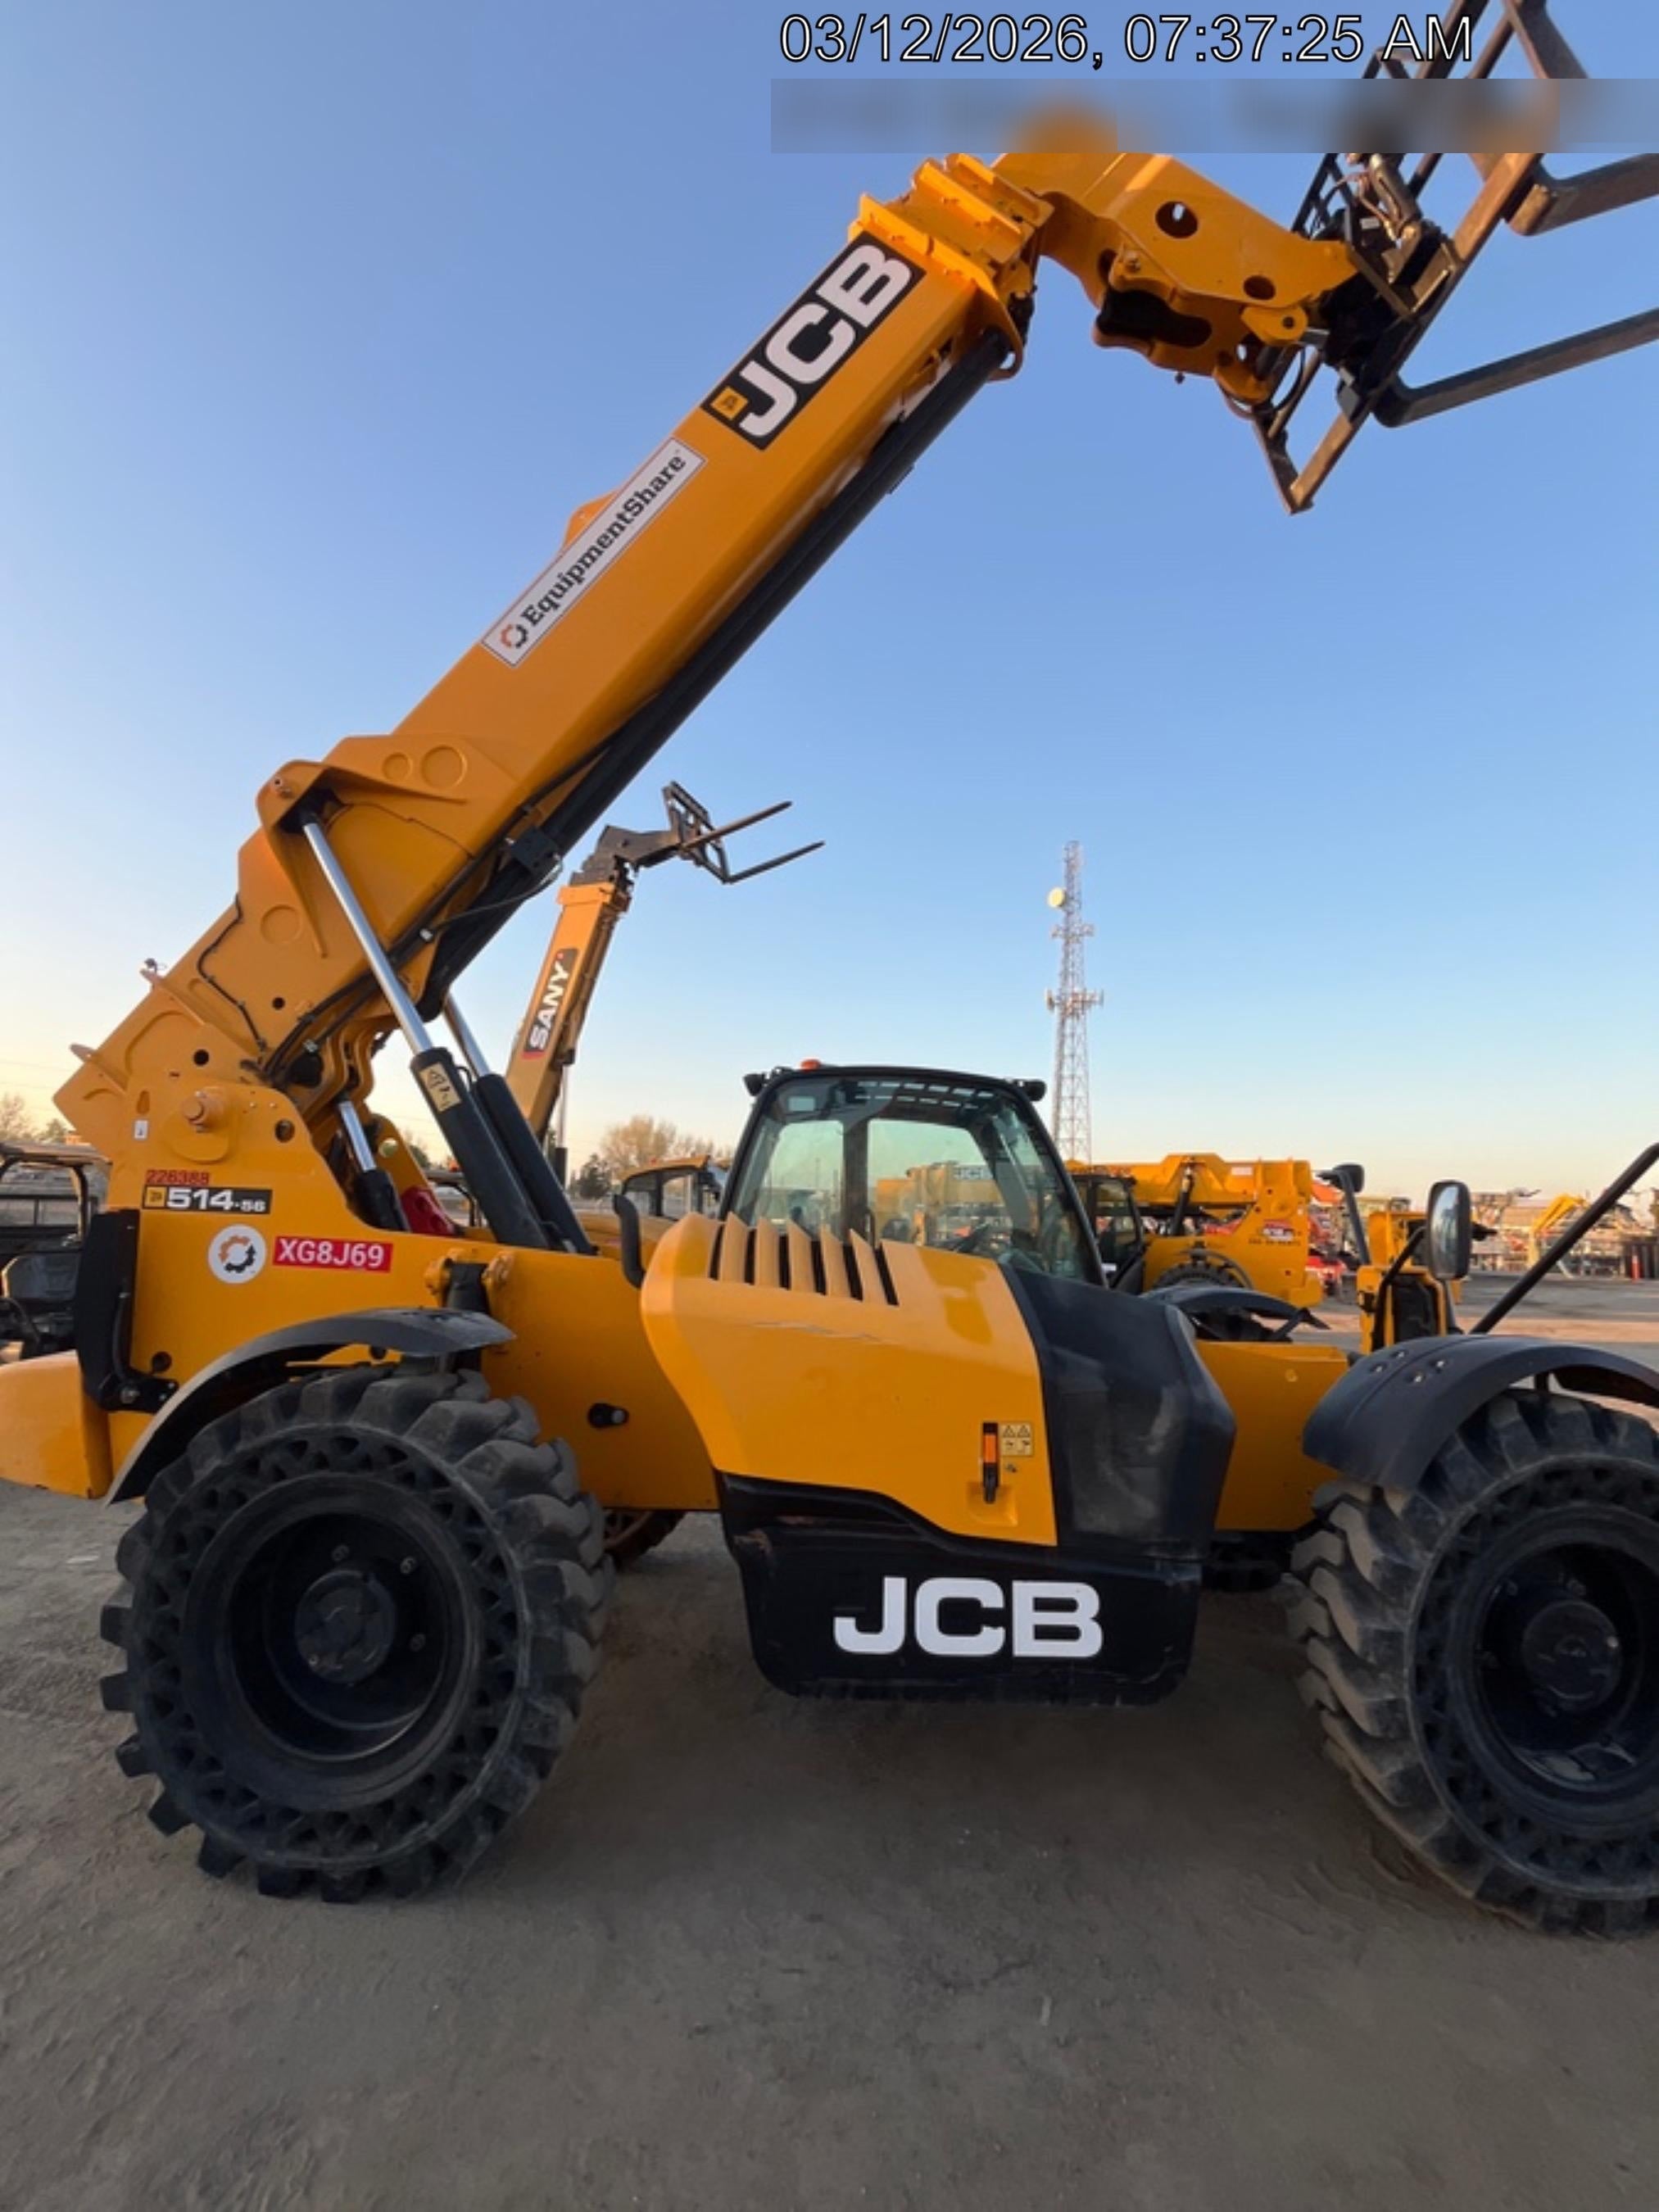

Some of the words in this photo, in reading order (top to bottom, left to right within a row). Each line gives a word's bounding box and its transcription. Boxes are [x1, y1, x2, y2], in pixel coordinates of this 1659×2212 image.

[738, 244, 913, 437] JCB
[520, 455, 687, 627] EquipmentShare
[529, 960, 570, 1050] SANY
[277, 1238, 385, 1268] XG8J69
[833, 1576, 1103, 1657] JCB
